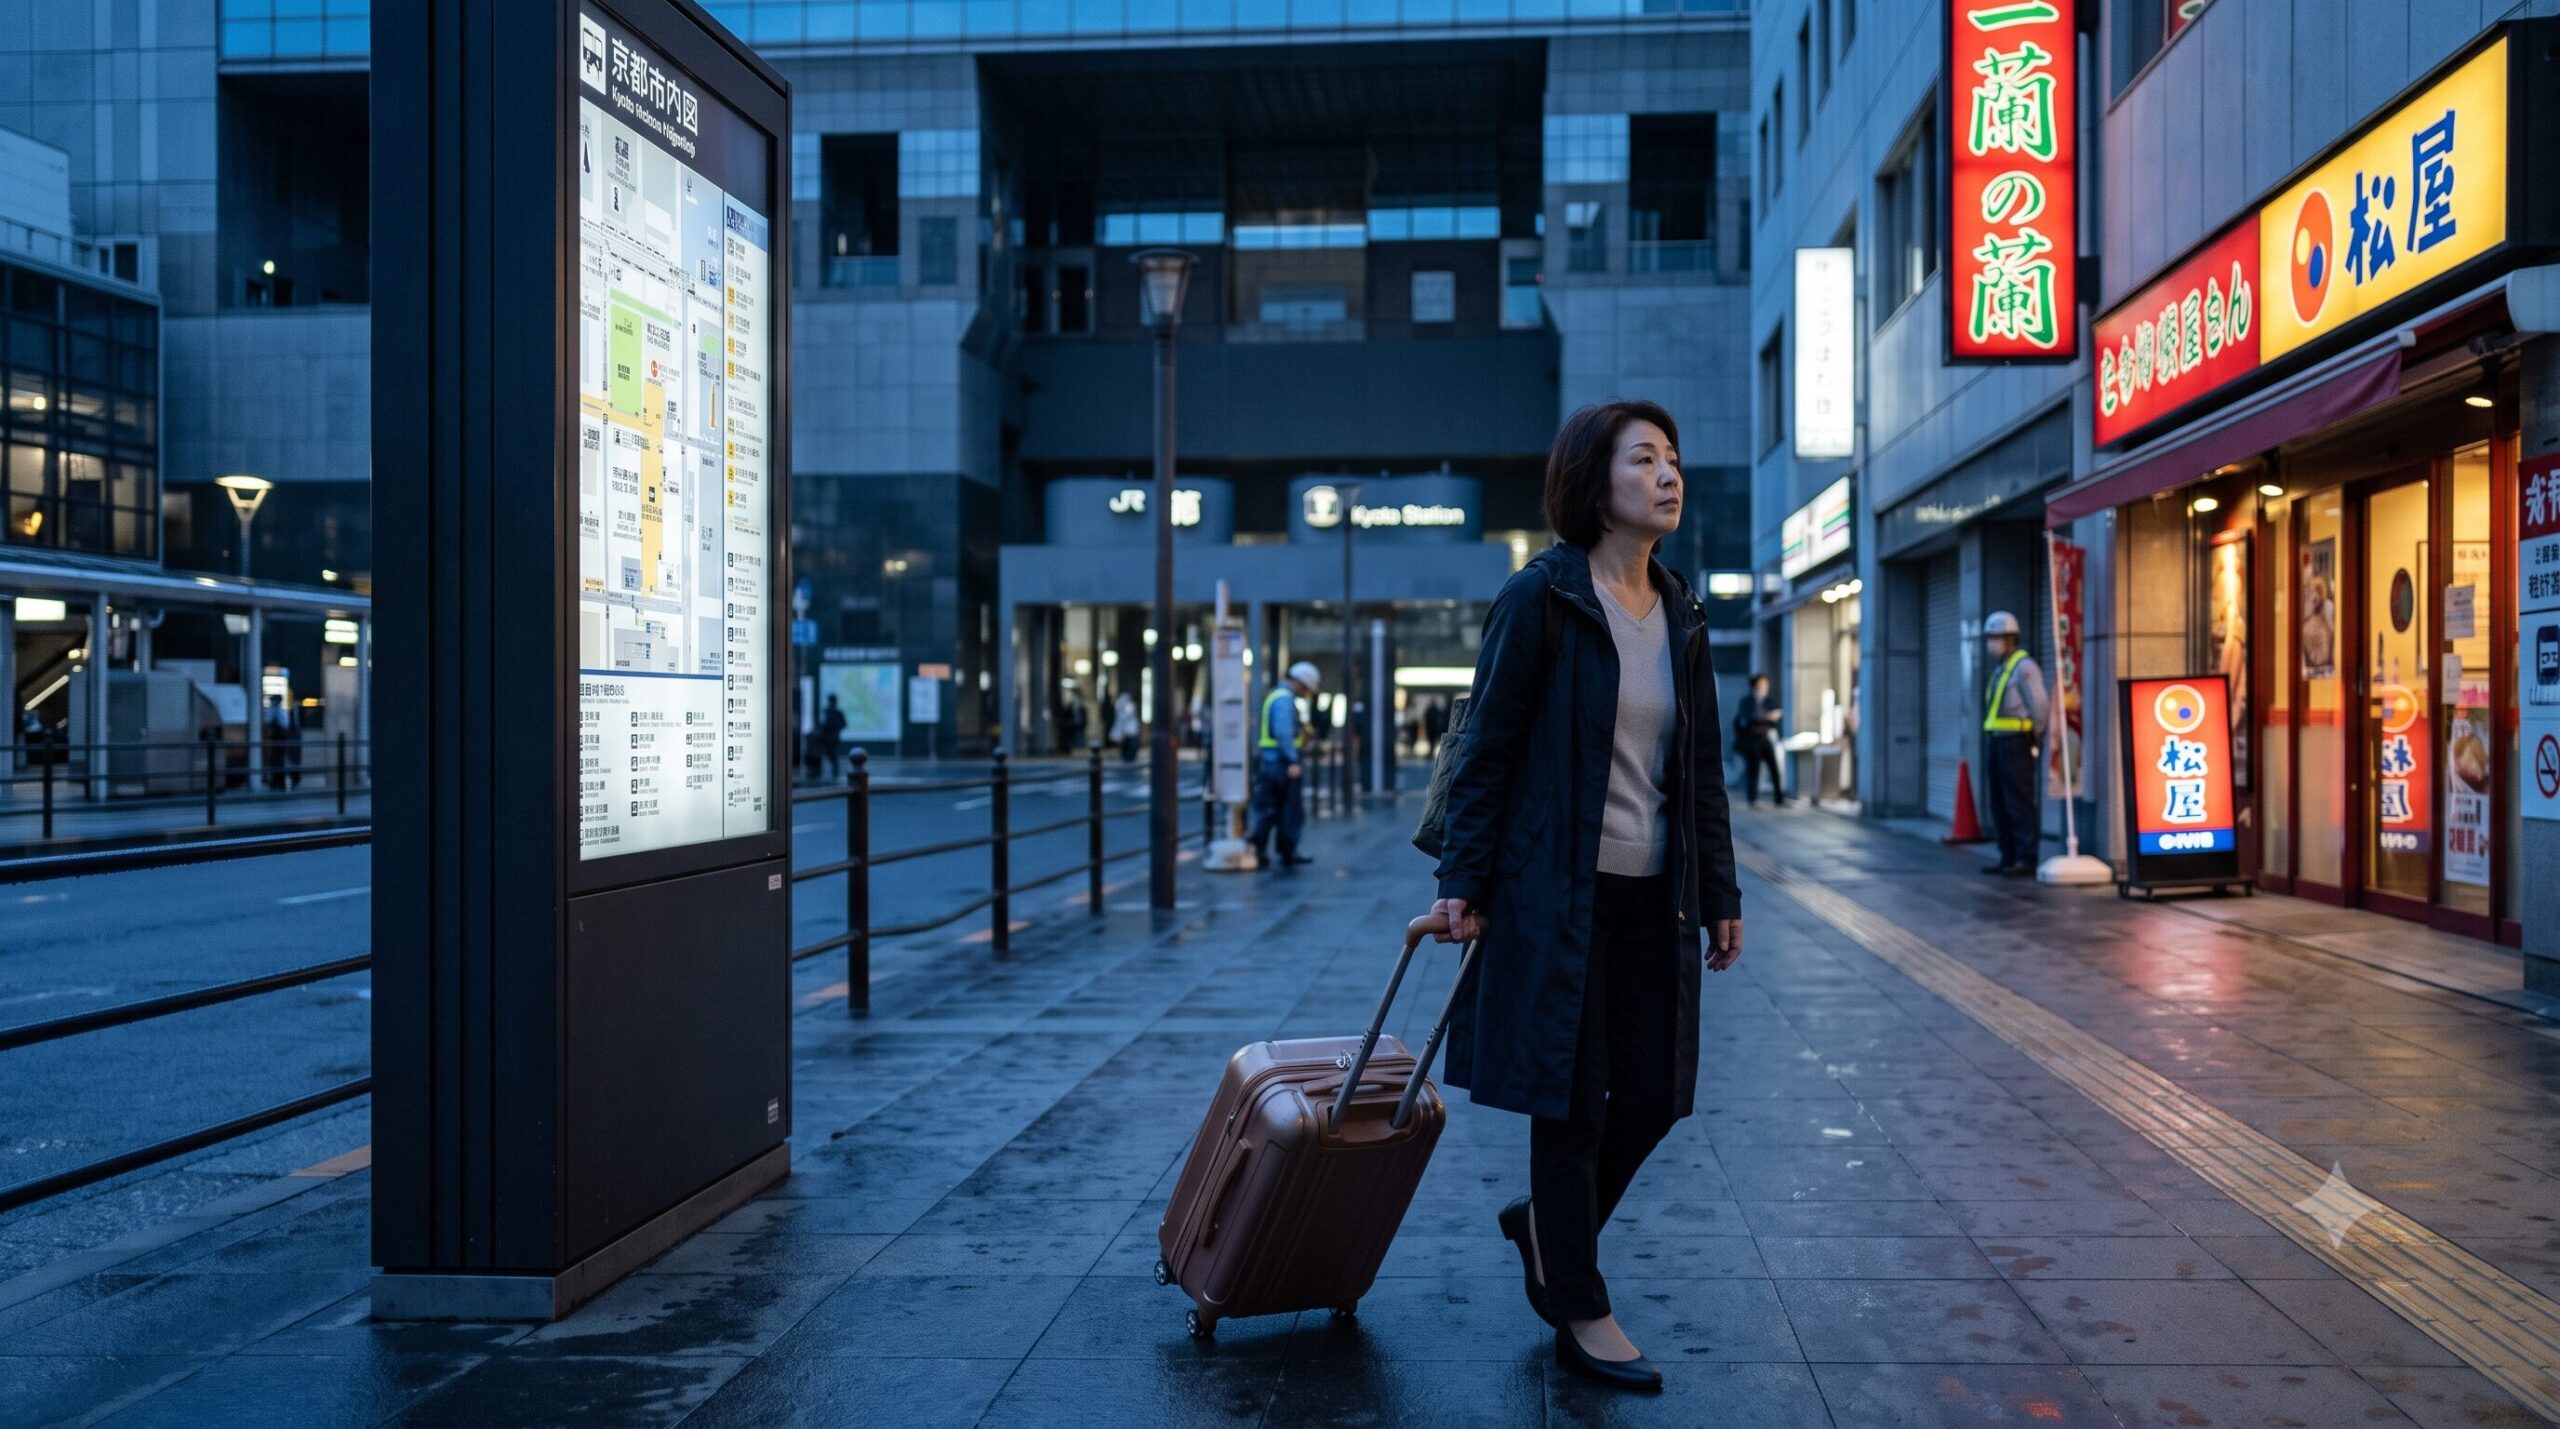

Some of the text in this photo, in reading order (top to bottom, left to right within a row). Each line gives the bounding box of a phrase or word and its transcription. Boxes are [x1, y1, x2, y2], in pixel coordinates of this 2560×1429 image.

[612, 36, 698, 136] 京都市内図
[1968, 1, 2059, 346] 一蘭の蘭
[2345, 109, 2457, 287] 松屋
[1350, 504, 1465, 529] Kyoto Station
[2158, 736, 2207, 823] 松屋
